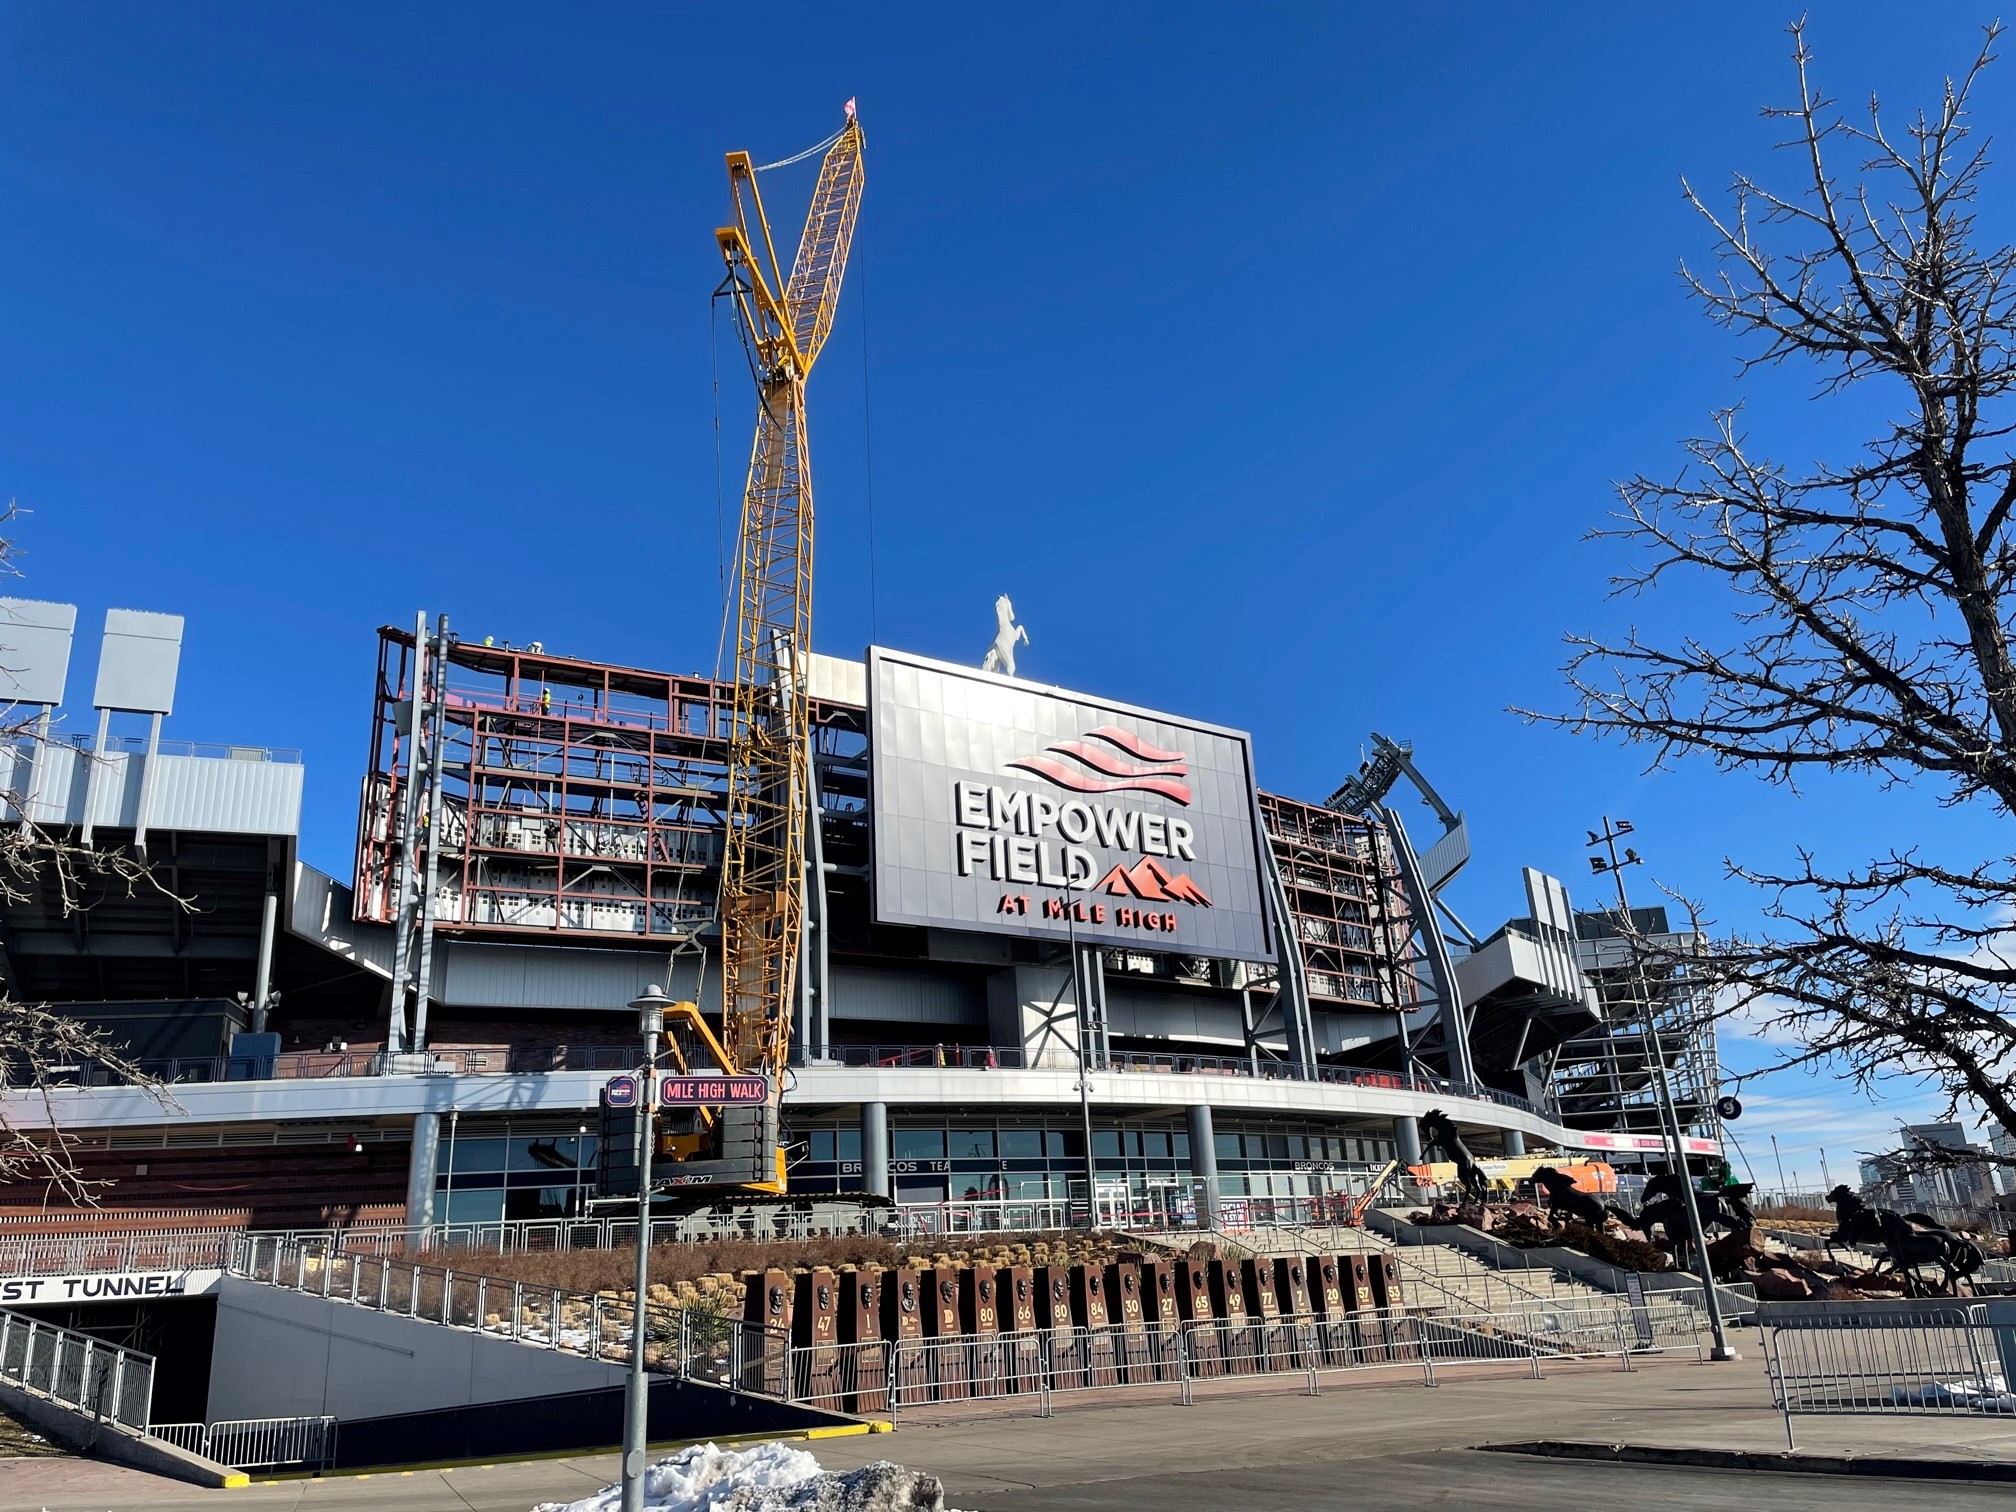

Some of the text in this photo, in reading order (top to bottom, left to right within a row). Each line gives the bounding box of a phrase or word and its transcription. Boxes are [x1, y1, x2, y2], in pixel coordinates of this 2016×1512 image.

[955, 780, 1197, 861] EMPOWER
[957, 830, 1098, 890] FIELD
[998, 894, 1031, 917] AT
[1115, 907, 1177, 933] HIGH
[667, 1083, 762, 1099] MILE HIGH WALK
[1723, 1101, 1735, 1115] 9
[1294, 1161, 1334, 1171] BRONCOS
[0, 1276, 184, 1300] ST TUNNEL
[1326, 1288, 1339, 1301] 20
[1358, 1286, 1369, 1299] 57
[1388, 1285, 1401, 1298] 53
[1195, 1296, 1209, 1309] 65
[1229, 1293, 1241, 1307] 49
[1261, 1292, 1273, 1305] 77
[1296, 1290, 1303, 1303] 7
[1054, 1304, 1068, 1318] 80
[1090, 1302, 1104, 1316] 84
[1125, 1299, 1139, 1313] 30
[1161, 1298, 1173, 1312] 27
[980, 1307, 994, 1322] 80
[1018, 1306, 1031, 1320] 66
[769, 1318, 785, 1334] 24
[817, 1316, 831, 1332] 47
